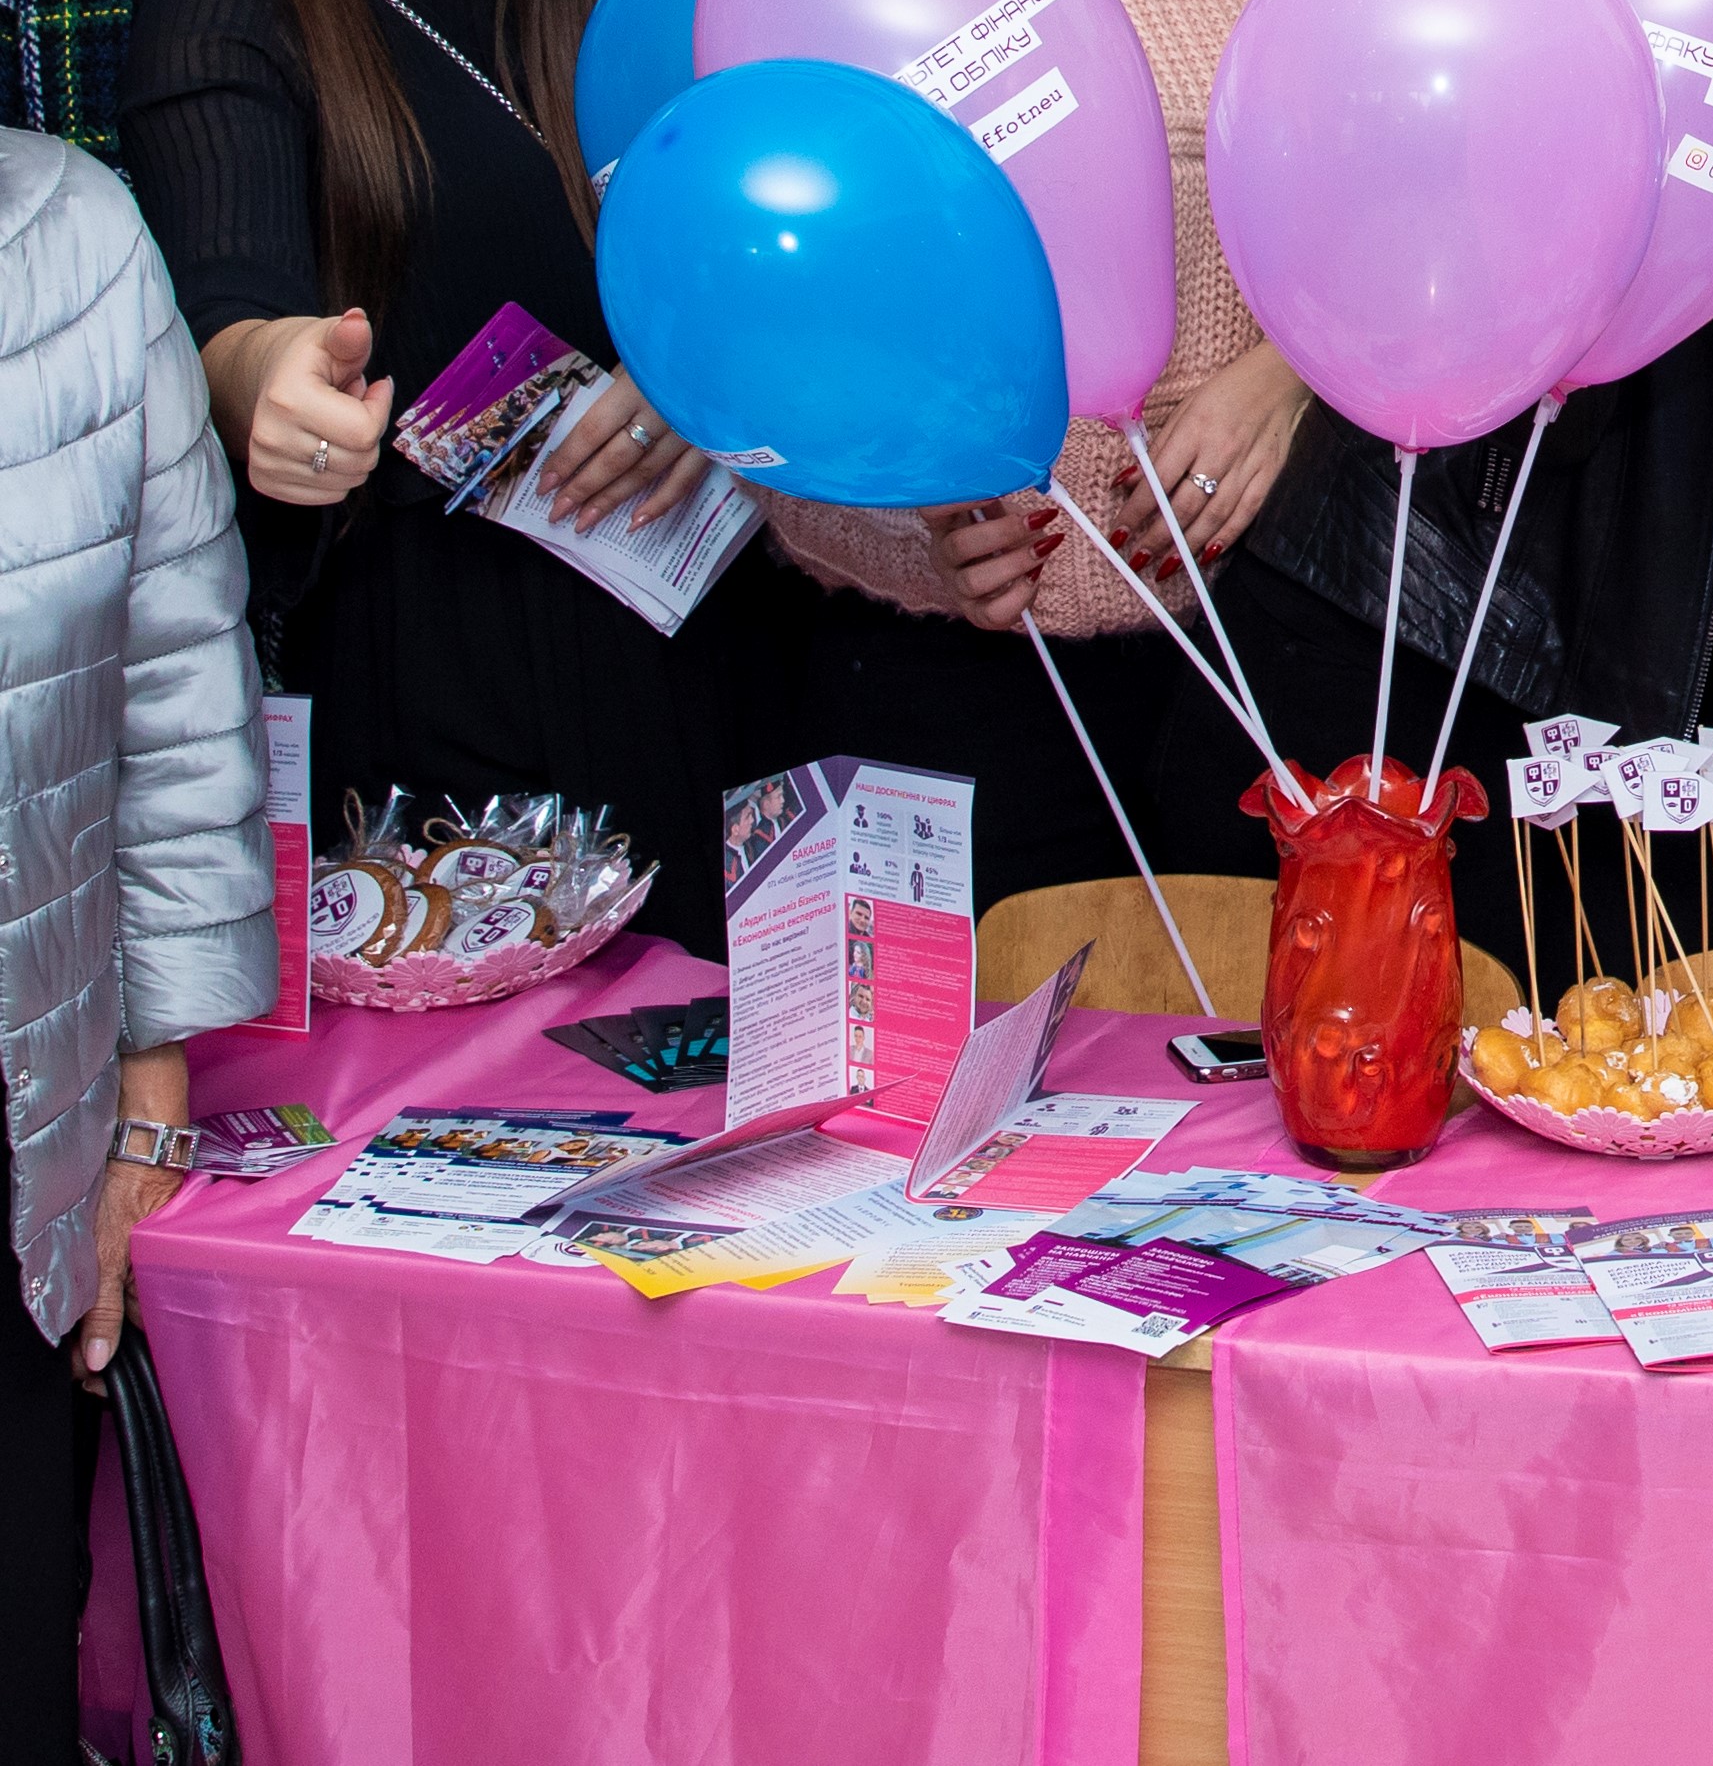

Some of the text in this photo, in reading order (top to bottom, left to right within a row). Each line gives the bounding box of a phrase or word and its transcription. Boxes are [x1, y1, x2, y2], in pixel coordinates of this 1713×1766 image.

[949, 28, 1031, 92] ОБЛІКУ
[982, 87, 1063, 149] ffotneu
[792, 837, 837, 861] БАКАЛАВР
[1052, 1244, 1120, 1258] ЗАПРОШУЄМ
[1607, 1260, 1664, 1273] КАФЕДРА
